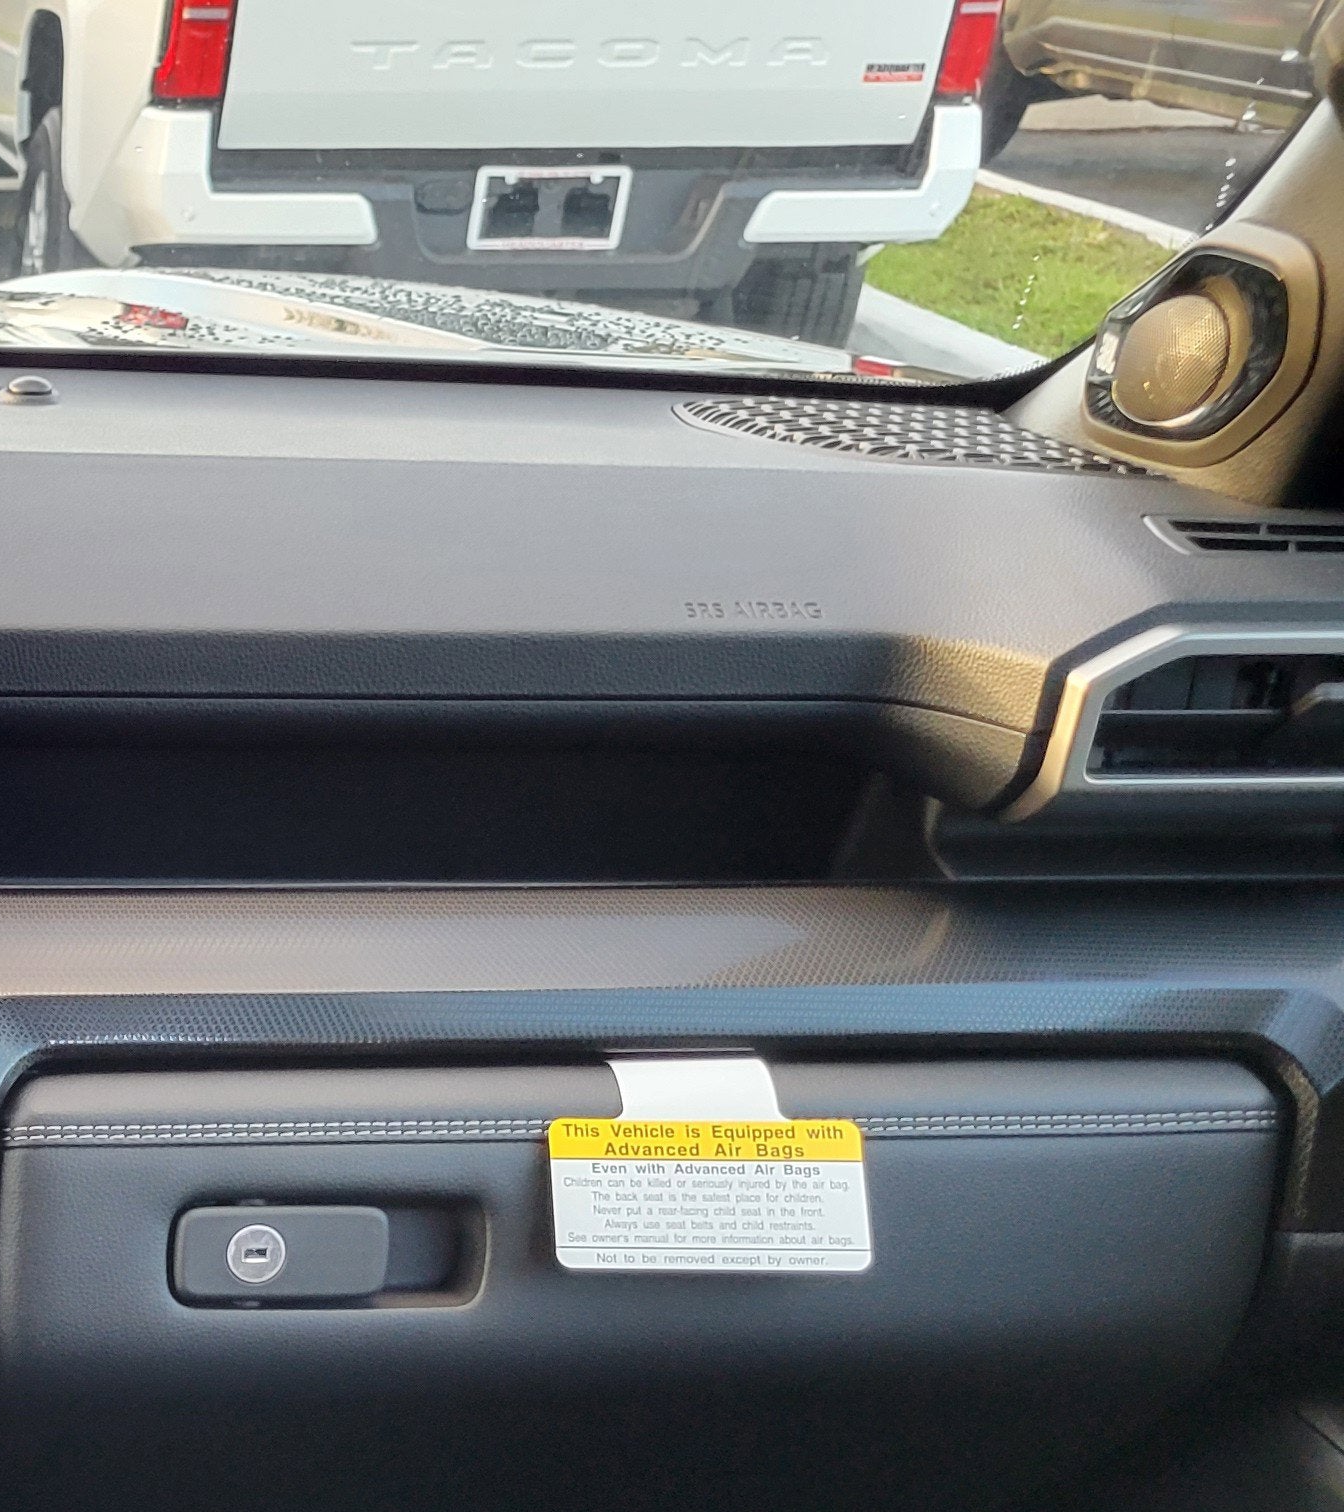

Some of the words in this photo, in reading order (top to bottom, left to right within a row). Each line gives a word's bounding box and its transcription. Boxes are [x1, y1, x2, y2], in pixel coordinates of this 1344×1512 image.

[350, 36, 829, 71] TACOMA
[684, 601, 724, 618] SRS
[735, 601, 823, 619] AIRBAG
[563, 1123, 599, 1138] This
[610, 1124, 674, 1138] Vehicle
[685, 1125, 700, 1138] is
[712, 1125, 795, 1141] Equipped
[807, 1126, 843, 1139] with
[605, 1143, 700, 1156] Advanced
[715, 1143, 741, 1157] Air
[757, 1144, 805, 1159] Bags
[592, 1163, 627, 1174] Even
[635, 1163, 665, 1174] with
[674, 1163, 745, 1175] Advanced
[754, 1164, 775, 1175] Air
[784, 1165, 820, 1178] Bags
[563, 1177, 602, 1187] Children
[608, 1179, 625, 1188] can
[630, 1178, 642, 1188] be
[647, 1177, 672, 1188] killed
[676, 1179, 686, 1188] or
[692, 1178, 733, 1190] seriously
[738, 1179, 770, 1190] injured
[775, 1180, 787, 1191] by
[792, 1180, 807, 1189] the
[812, 1180, 824, 1189] air
[591, 1191, 610, 1201] The
[615, 1191, 637, 1201] back
[643, 1192, 663, 1201] seat
[668, 1192, 677, 1201] is
[681, 1192, 696, 1201] the
[736, 1193, 761, 1205] place
[766, 1193, 778, 1202] for
[592, 1205, 621, 1215] Never
[627, 1205, 641, 1217] put
[647, 1207, 653, 1215] a
[714, 1206, 735, 1216] child
[741, 1207, 761, 1216] seat
[766, 1207, 775, 1216] in
[780, 1207, 795, 1216] the
[604, 1219, 638, 1231] Always
[643, 1221, 660, 1229] use
[665, 1220, 686, 1230] seat
[691, 1220, 713, 1230] belts
[719, 1221, 736, 1230] and
[742, 1221, 764, 1230] child
[568, 1232, 586, 1243] See
[592, 1233, 629, 1243] owner's
[634, 1234, 668, 1243] manual
[674, 1234, 686, 1243] for
[692, 1235, 716, 1244] more
[722, 1235, 774, 1244] information
[779, 1235, 806, 1244] about
[811, 1235, 823, 1245] air
[596, 1253, 617, 1264] Not
[624, 1254, 635, 1264] to
[642, 1254, 656, 1264] be
[664, 1254, 715, 1264] removed
[722, 1255, 760, 1267] except
[768, 1255, 781, 1266] by
[789, 1256, 828, 1266] owner.
